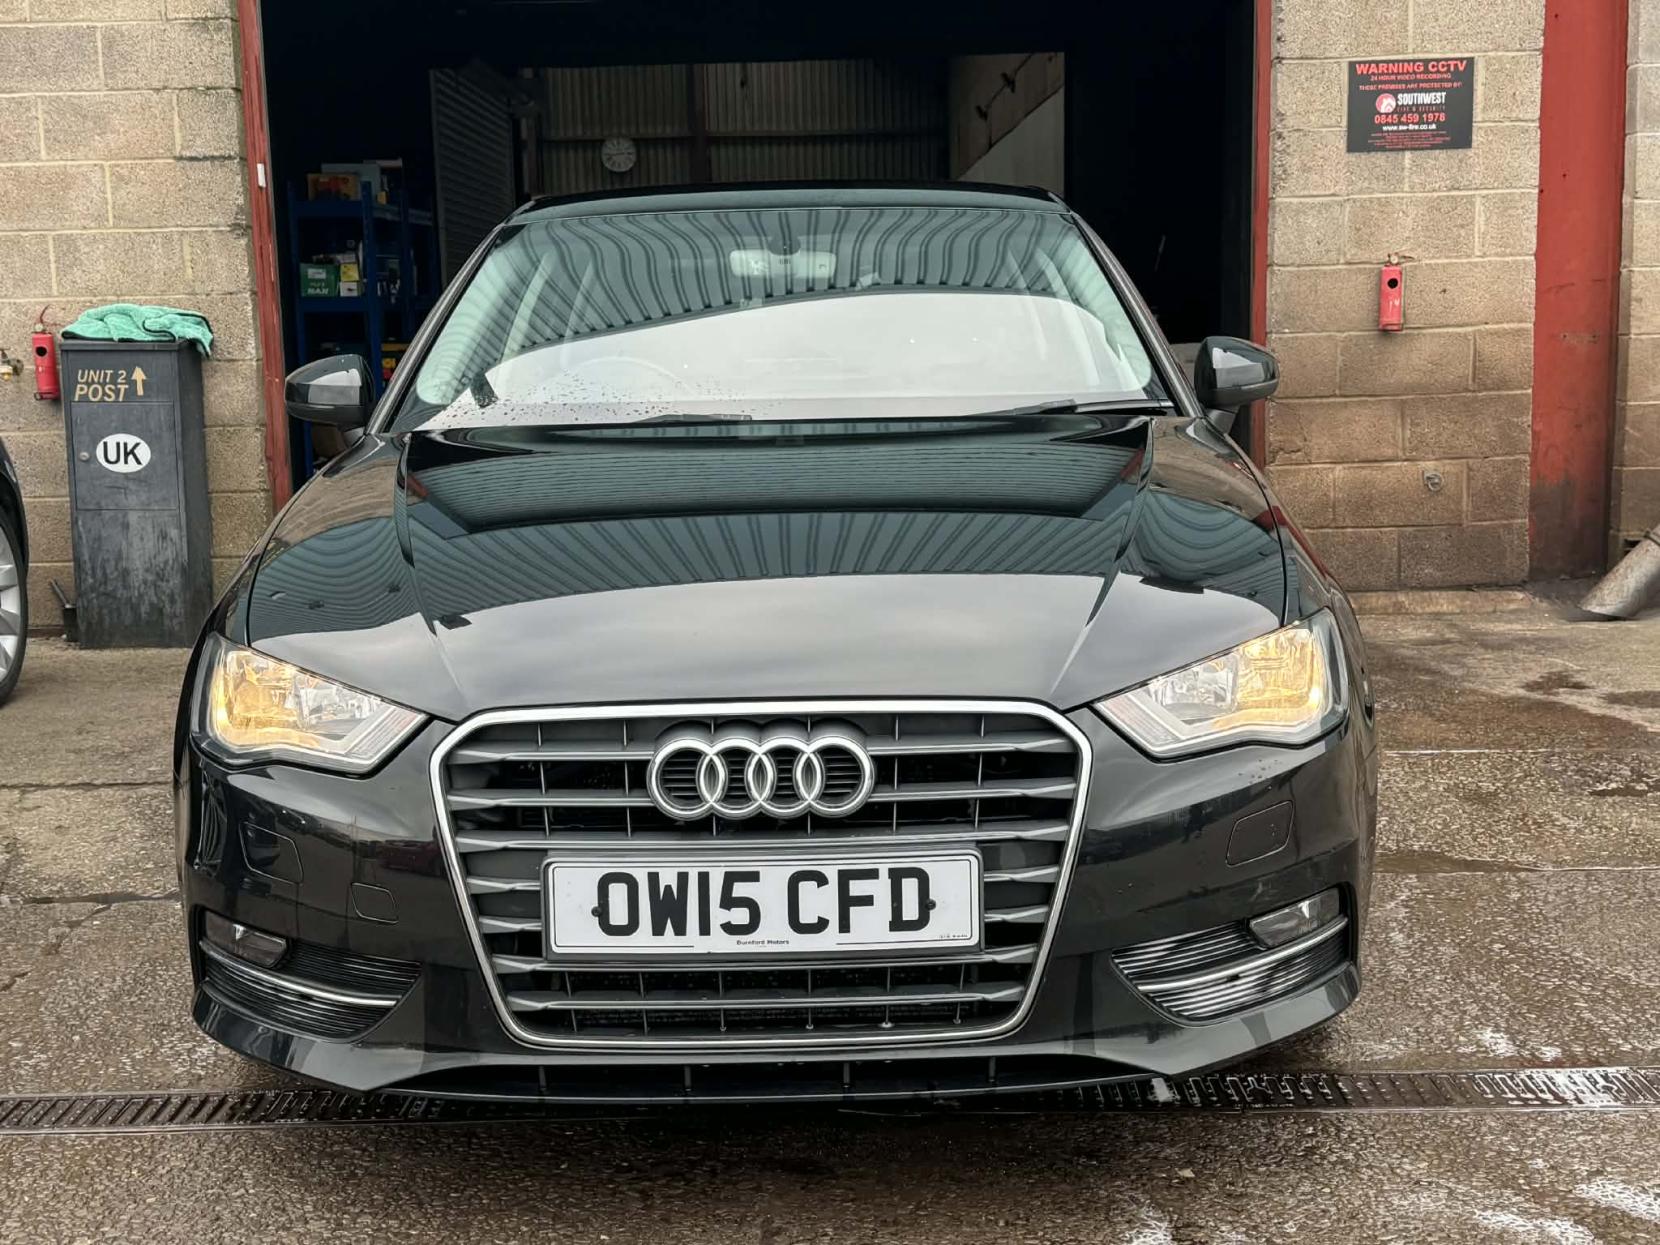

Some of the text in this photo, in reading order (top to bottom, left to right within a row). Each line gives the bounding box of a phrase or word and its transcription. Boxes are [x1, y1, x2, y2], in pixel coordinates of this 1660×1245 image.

[1355, 60, 1467, 75] WARNING CCTV
[1397, 91, 1447, 106] SOUTHWEST
[1374, 114, 1399, 124] 0845
[1400, 113, 1420, 124] 459
[77, 369, 127, 383] UNIT 2
[74, 384, 129, 402] POST
[103, 441, 142, 466] UK
[597, 866, 931, 937] OW15 CFD
